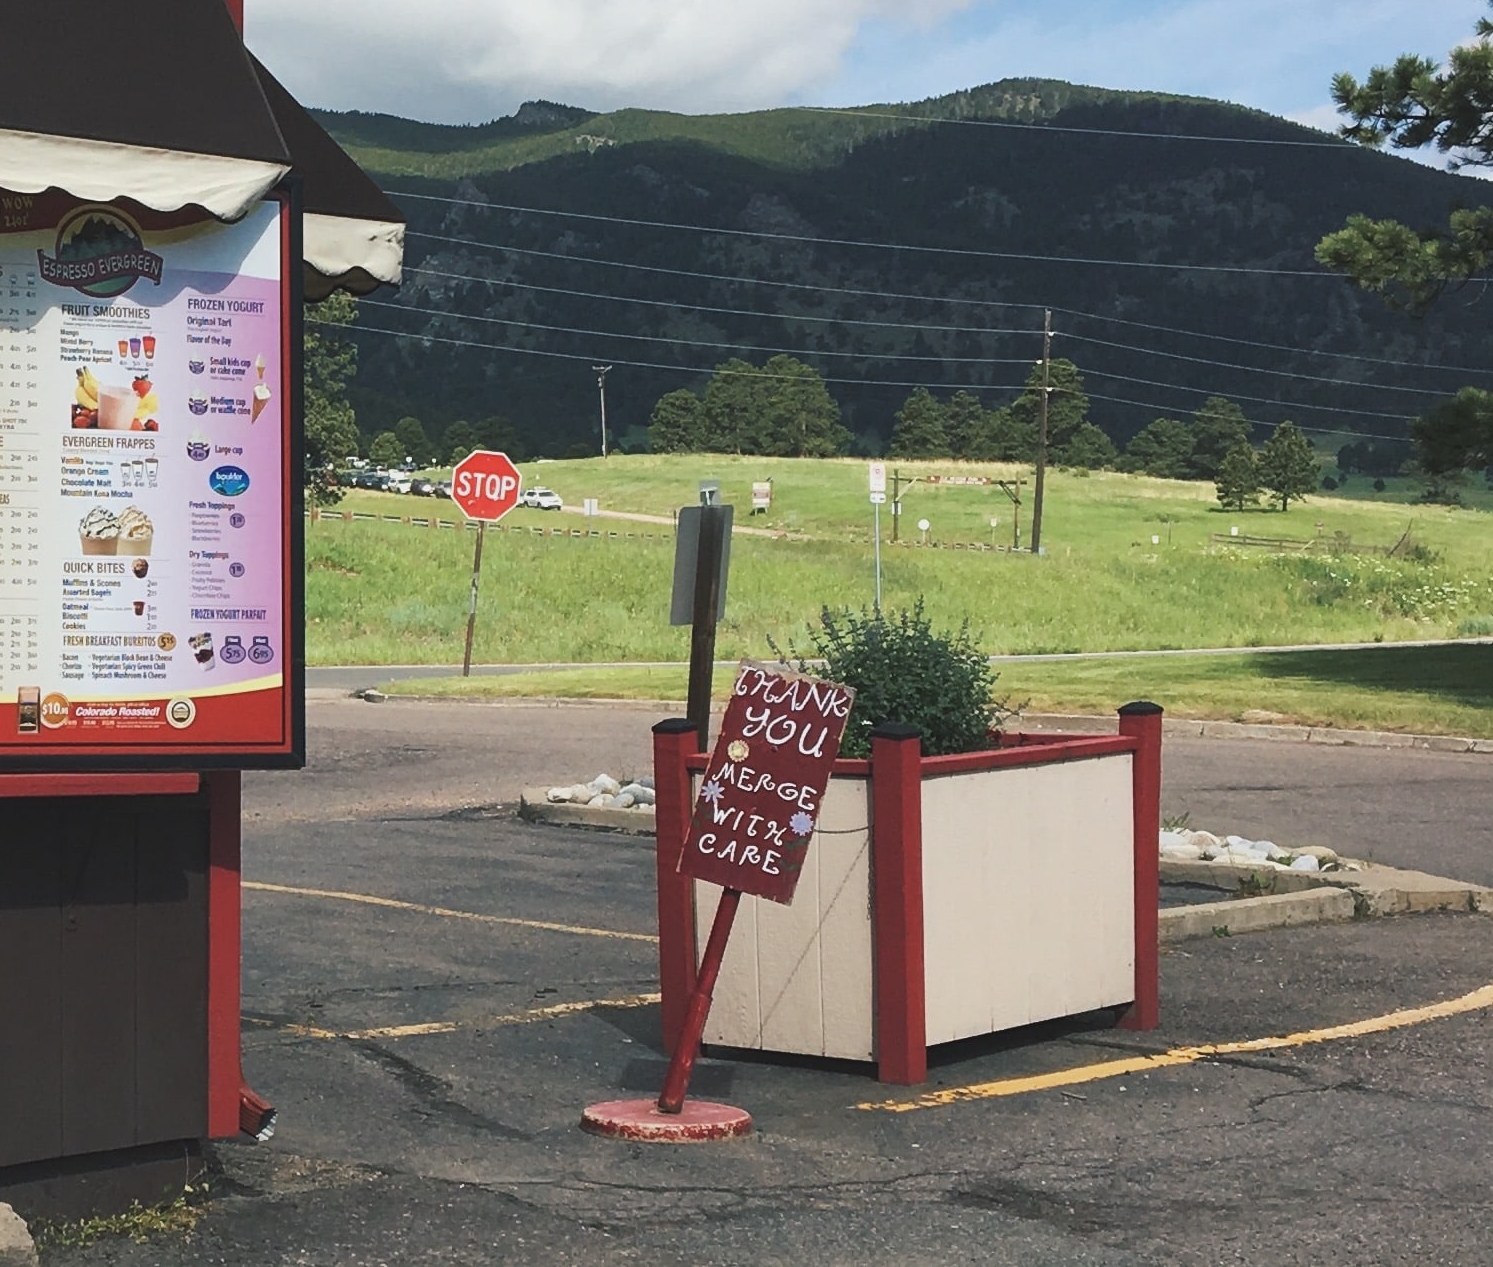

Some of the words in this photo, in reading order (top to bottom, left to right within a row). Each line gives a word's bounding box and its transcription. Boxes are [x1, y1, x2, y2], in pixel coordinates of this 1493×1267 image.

[42, 259, 96, 280] ESPRESSO
[98, 254, 161, 276] EVERGREEN
[61, 304, 91, 317] FRUIT
[93, 305, 150, 320] SMOOTHIES
[188, 298, 225, 312] FROZEN
[227, 300, 265, 314] YOGURT
[187, 316, 216, 327] Original
[218, 317, 232, 327] Tart
[210, 356, 227, 366] Small
[228, 357, 240, 367] kids
[210, 396, 235, 405] Medium
[62, 435, 114, 448] EVERGREEN
[116, 437, 155, 450] FRAPPES
[61, 467, 86, 476] Orange
[61, 478, 95, 487] Chocolate
[96, 479, 112, 487] Malt
[456, 470, 516, 501] STOP
[189, 550, 200, 560] Dry
[63, 562, 94, 574] QUICK
[96, 563, 126, 574] BITES
[62, 603, 89, 611] Oatmeal
[190, 608, 215, 620] FROZEN
[216, 609, 241, 621] YOGURT
[241, 609, 267, 621] PARFAIT
[62, 622, 86, 630] Cookies
[63, 635, 84, 647] FRESH
[85, 635, 122, 647] BREAKFAST
[123, 636, 156, 647] BURRITOS
[734, 664, 849, 718] THANK
[75, 706, 117, 717] Colorado
[118, 706, 161, 717] Roasted!
[741, 705, 828, 758] YOU
[711, 762, 819, 812] MERGE
[712, 799, 788, 847] WITH
[698, 832, 782, 876] CARE
